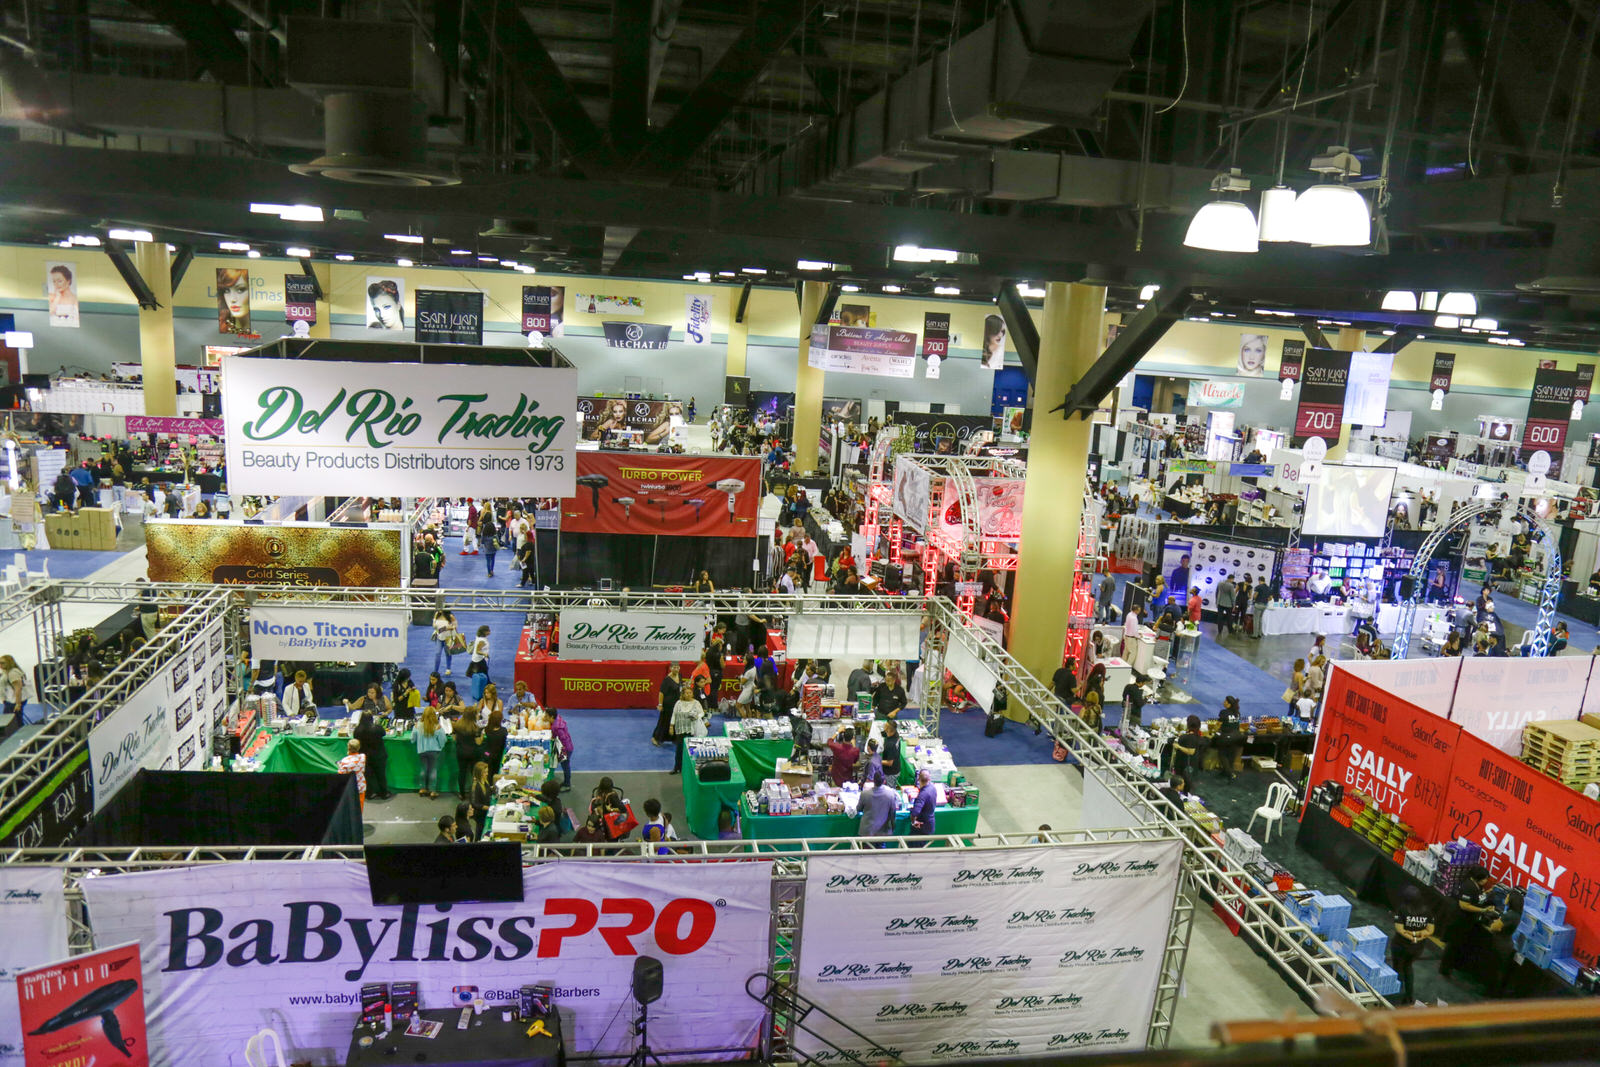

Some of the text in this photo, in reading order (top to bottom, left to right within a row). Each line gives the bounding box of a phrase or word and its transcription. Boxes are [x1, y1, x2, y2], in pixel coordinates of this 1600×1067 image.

[290, 306, 312, 317] 900
[420, 312, 478, 329] SAN JUAN
[526, 318, 546, 328] 800
[687, 296, 704, 344] Fidelity
[614, 340, 654, 349] LECHAT
[927, 342, 944, 352] 700
[1282, 366, 1298, 376] 500
[1306, 367, 1348, 382] SAN JUAN
[1434, 378, 1448, 387] 400
[1198, 383, 1242, 399] Miracle
[1535, 384, 1574, 399] SAN JUAN
[1574, 389, 1588, 398] 300
[242, 386, 346, 441] Del
[437, 392, 566, 454] Trading
[1305, 412, 1334, 430] 700
[1530, 426, 1560, 444] 600
[242, 450, 564, 472] Beauty Products Distributors since 1973
[618, 467, 704, 482] TURBO POWER
[246, 569, 309, 580] Gold Series
[254, 620, 400, 638] Nano Titanium
[568, 622, 609, 640] Del
[645, 626, 696, 646] Trading
[288, 638, 338, 649] BaByliss
[340, 638, 367, 648] PRO
[560, 678, 650, 692] TURBO POWER
[99, 741, 122, 785] Del
[1348, 743, 1413, 793] SALLY
[1345, 766, 1408, 814] BEAUTY
[1448, 801, 1470, 827] ion
[1526, 818, 1574, 854] Beautique
[1482, 822, 1567, 890] SALLY
[953, 869, 982, 882] Del
[1007, 866, 1044, 880] Trading
[1072, 862, 1100, 876] Del
[1124, 860, 1160, 872] Trading
[826, 874, 857, 888] Del
[883, 872, 923, 886] Trading
[4, 889, 42, 900] Trading
[886, 917, 916, 930] Del
[940, 914, 979, 928] Trading
[1008, 910, 1037, 924] Del
[1060, 908, 1096, 920] Trading
[161, 898, 717, 982] BaBylissPRO
[942, 958, 972, 970] Del
[995, 955, 1032, 968] Trading
[1060, 950, 1088, 963] Del
[1111, 946, 1145, 959] Trading
[818, 964, 849, 977] Del
[874, 962, 913, 974] Trading
[996, 996, 1024, 1009] Del
[1047, 992, 1084, 1005] Trading
[876, 1004, 904, 1016] Del
[931, 1002, 968, 1014] Trading
[1048, 1033, 1075, 1046] Del
[1098, 1028, 1130, 1040] Trading
[932, 1042, 962, 1054] Del
[984, 1040, 1021, 1051] Trading
